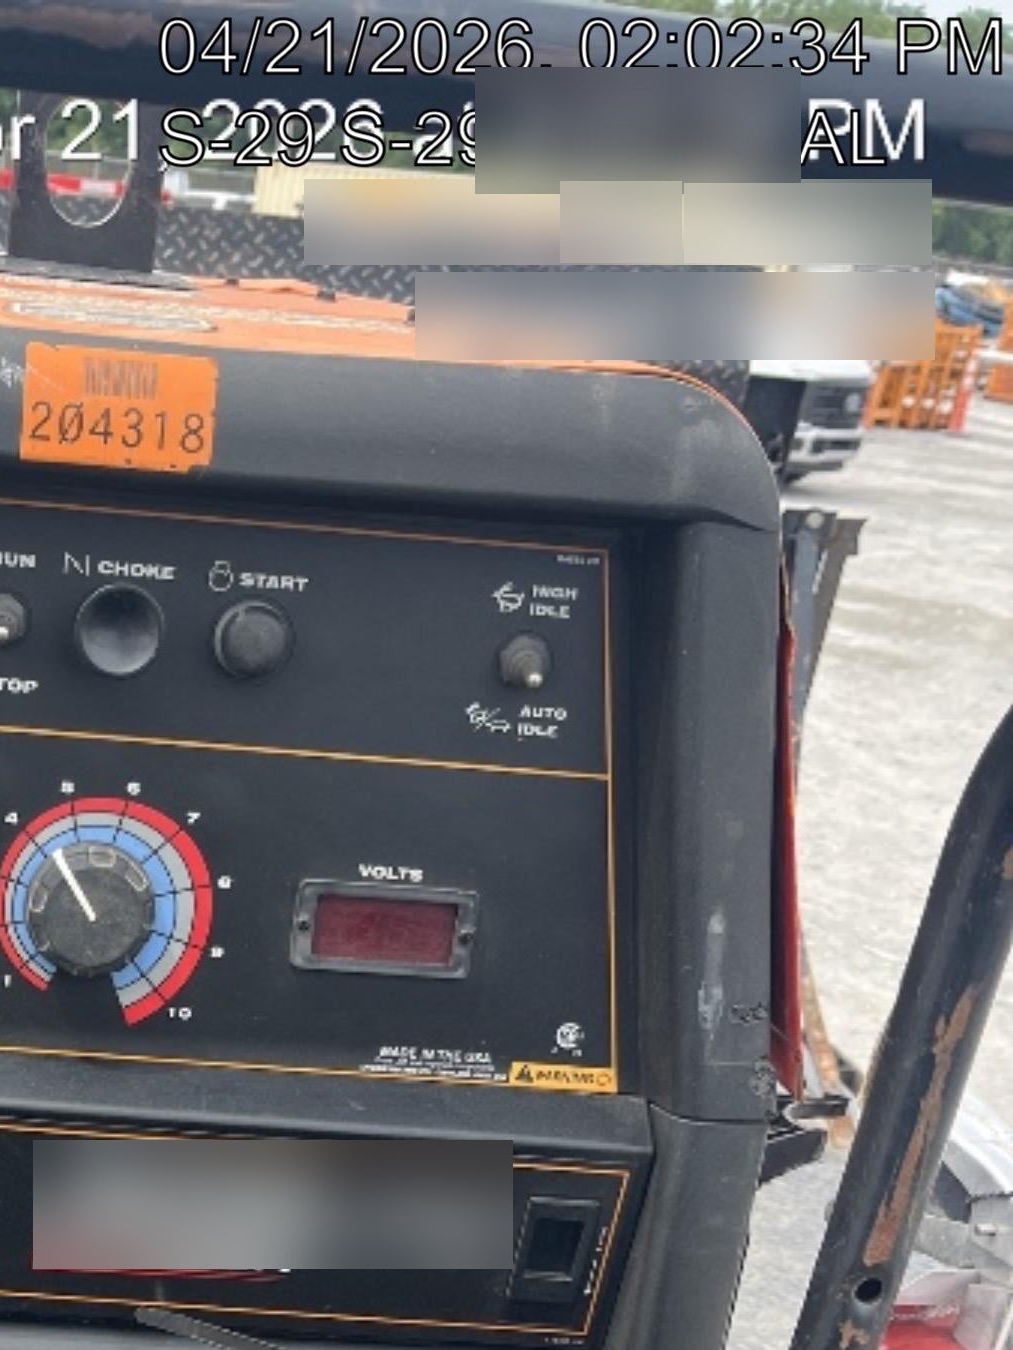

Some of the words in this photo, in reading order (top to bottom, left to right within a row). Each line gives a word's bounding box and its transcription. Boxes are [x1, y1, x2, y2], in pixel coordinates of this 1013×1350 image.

[29, 401, 204, 453] 204318
[97, 560, 176, 580] CHOKE
[238, 572, 309, 592] START
[529, 603, 571, 619] IDLE
[519, 704, 568, 721] AUTO
[517, 723, 559, 739] IDLE
[4, 811, 19, 824] 4
[186, 811, 201, 824] 7
[358, 863, 424, 883] VOLTS
[3, 974, 11, 988] 1
[169, 1006, 192, 1020] 10
[379, 1046, 418, 1059] MADE
[437, 1049, 462, 1063] THE
